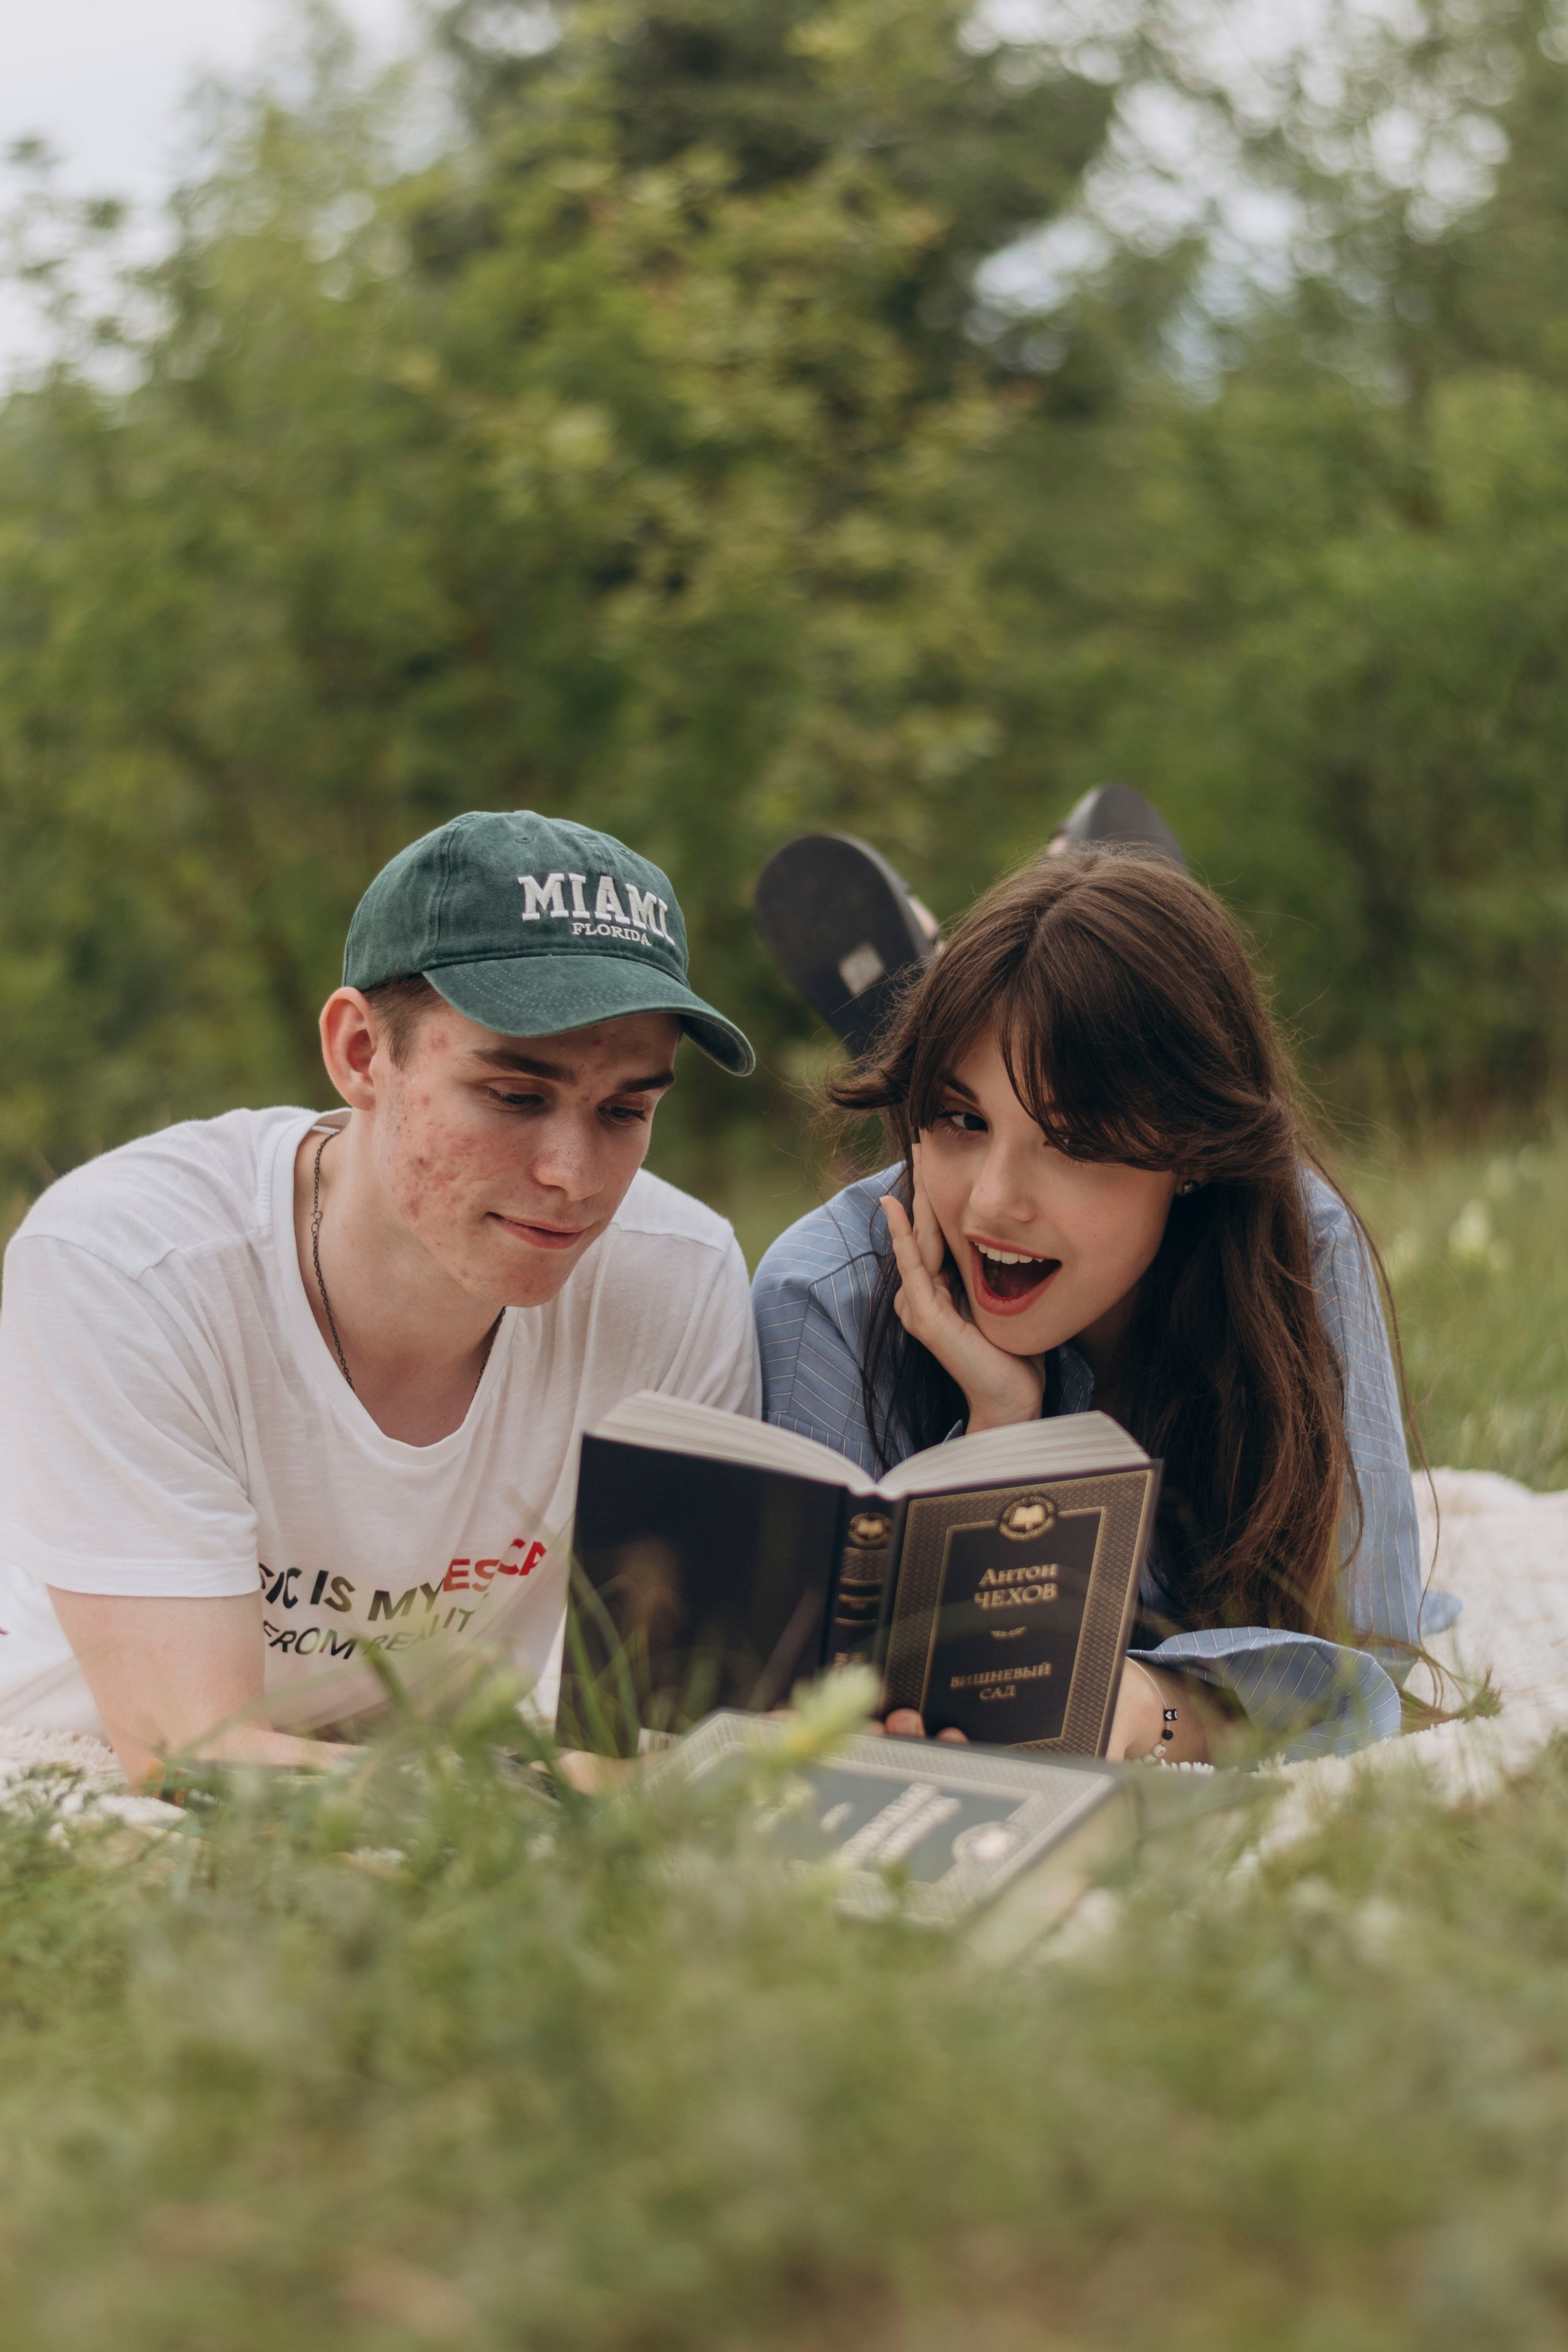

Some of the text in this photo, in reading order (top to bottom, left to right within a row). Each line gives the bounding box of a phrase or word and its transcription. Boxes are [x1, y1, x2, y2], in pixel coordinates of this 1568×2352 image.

[518, 873, 674, 946] MIAMI
[572, 922, 652, 946] FLORIDA
[311, 1570, 355, 1612] IS
[368, 1577, 445, 1621] MY
[974, 1583, 1058, 1610] ЧЕХОВ
[263, 1619, 358, 1660] FROM
[950, 1661, 1052, 1689] ВИШНЕВЫЙ
[979, 1684, 1017, 1701] САД
